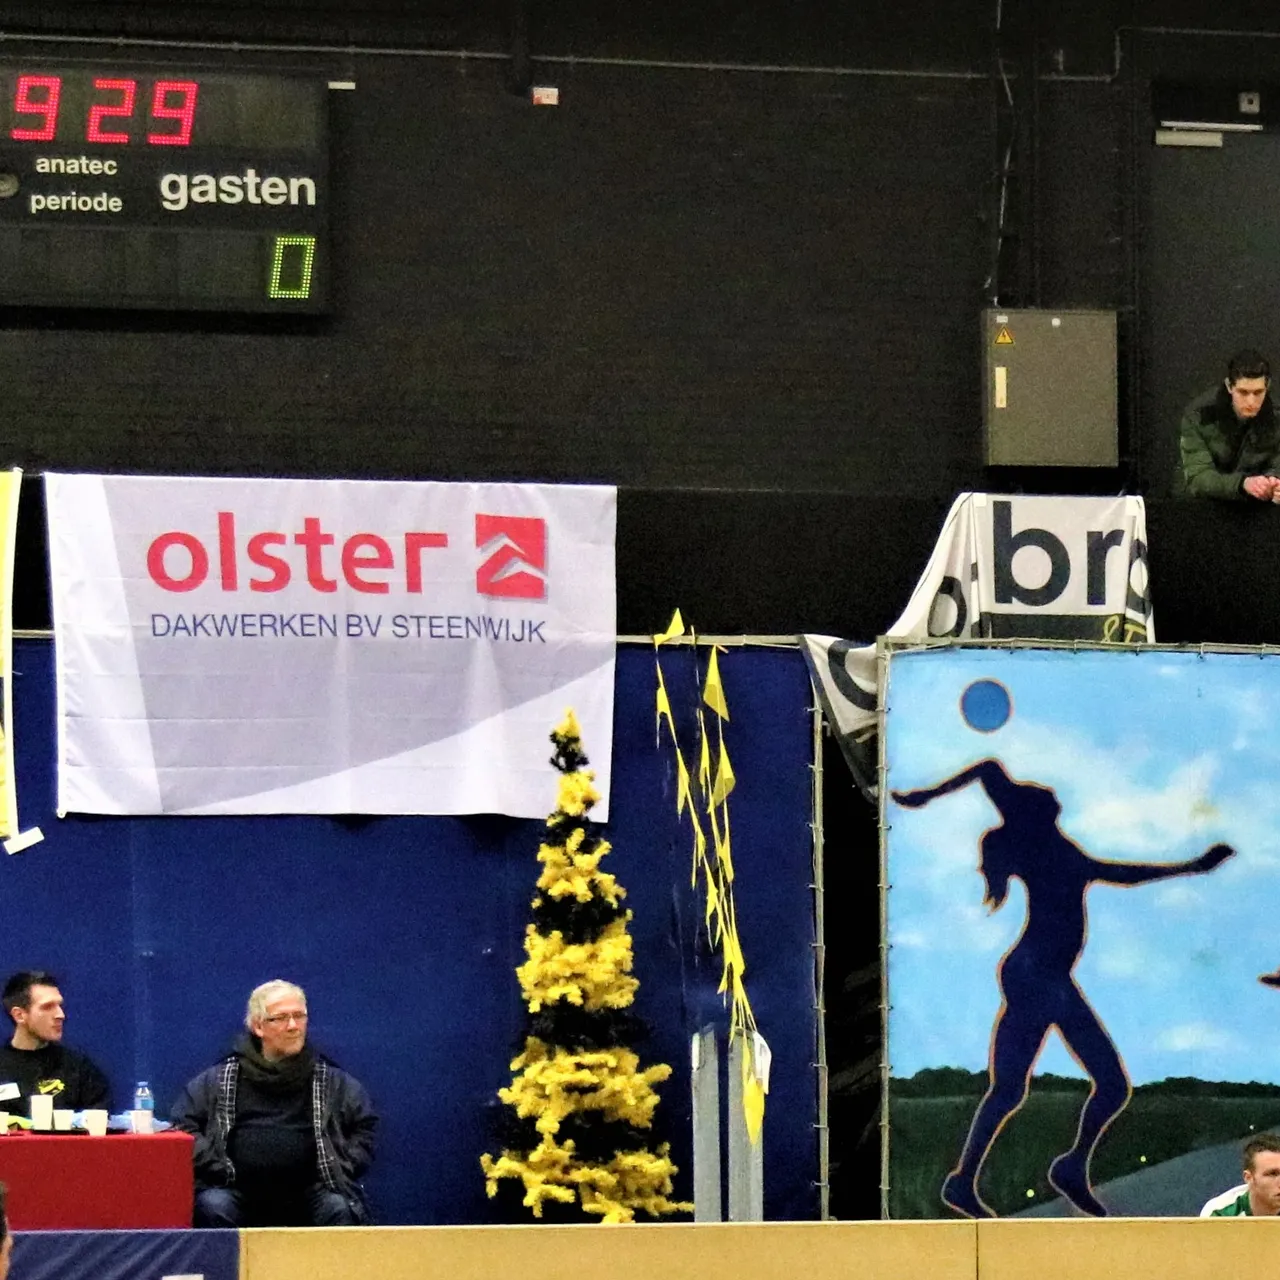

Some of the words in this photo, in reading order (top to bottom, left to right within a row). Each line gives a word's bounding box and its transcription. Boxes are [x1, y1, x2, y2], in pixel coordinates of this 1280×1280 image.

[36, 155, 118, 175] anatec
[30, 192, 122, 213] periode
[160, 169, 316, 210] gasten
[269, 236, 317, 299] 0
[147, 512, 448, 595] olster
[151, 614, 337, 638] DAKWERKEN
[346, 614, 383, 638] BV
[391, 615, 547, 643] STEENWIJK
